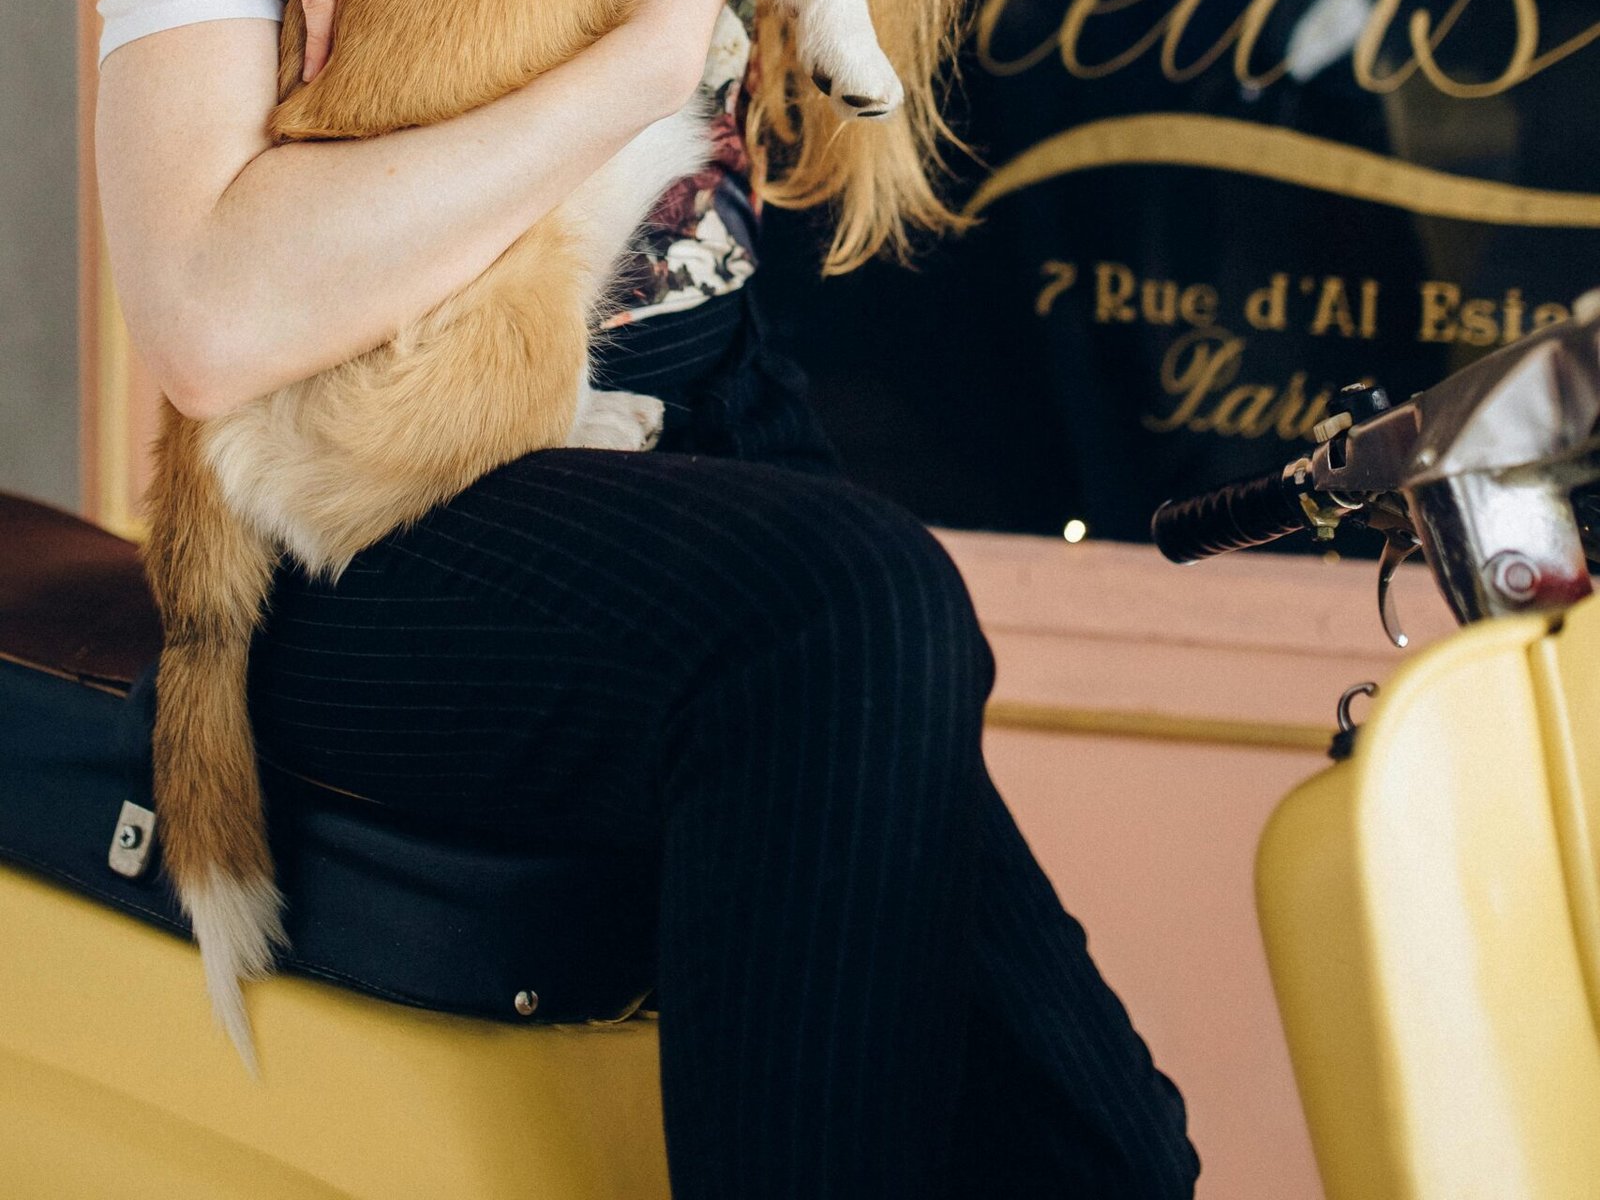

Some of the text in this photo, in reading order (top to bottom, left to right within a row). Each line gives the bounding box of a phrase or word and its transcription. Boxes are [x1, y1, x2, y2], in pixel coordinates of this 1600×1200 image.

[1034, 259, 1077, 317] 7
[1094, 260, 1218, 327] Rue
[1142, 324, 1374, 442] Pari
